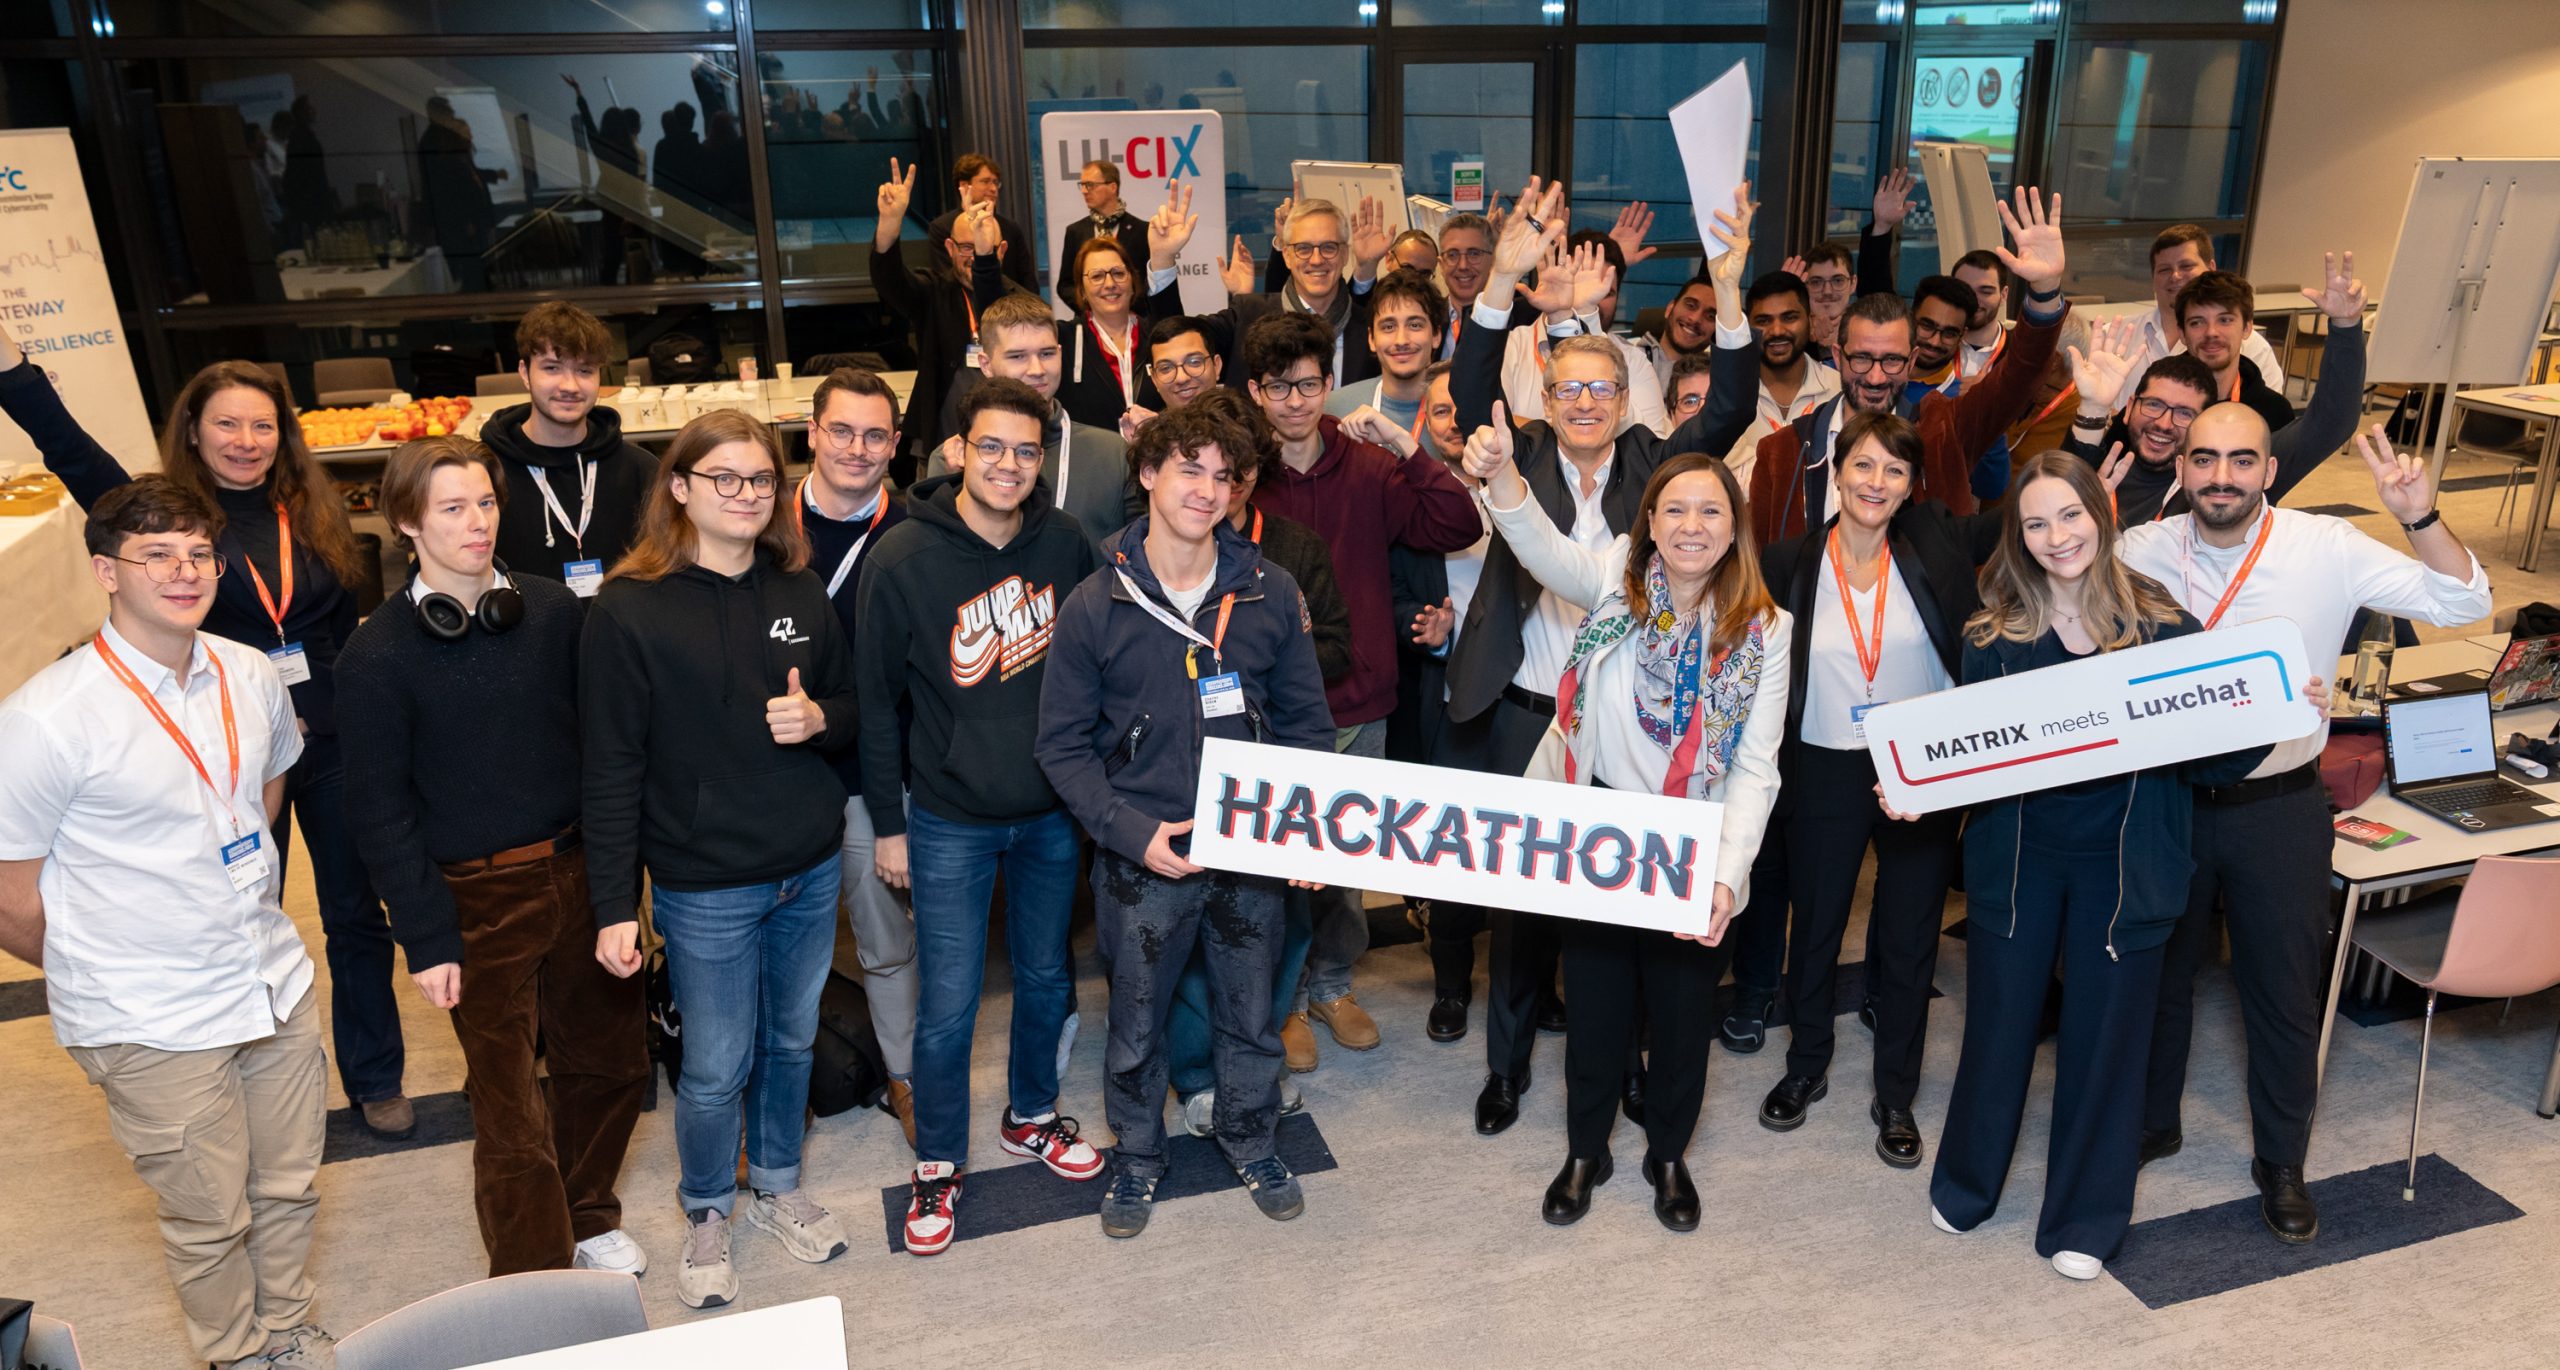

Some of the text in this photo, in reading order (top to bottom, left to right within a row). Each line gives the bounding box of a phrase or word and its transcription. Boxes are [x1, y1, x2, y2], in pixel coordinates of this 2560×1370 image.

[1176, 263, 1209, 276] ANGE
[2, 287, 27, 299] THE
[0, 299, 64, 321] TEWAY
[17, 324, 34, 335] TO
[769, 616, 797, 642] 42
[1924, 678, 2251, 762] MATRIX meets Luxchat
[1215, 773, 1698, 901] HACKATHON
